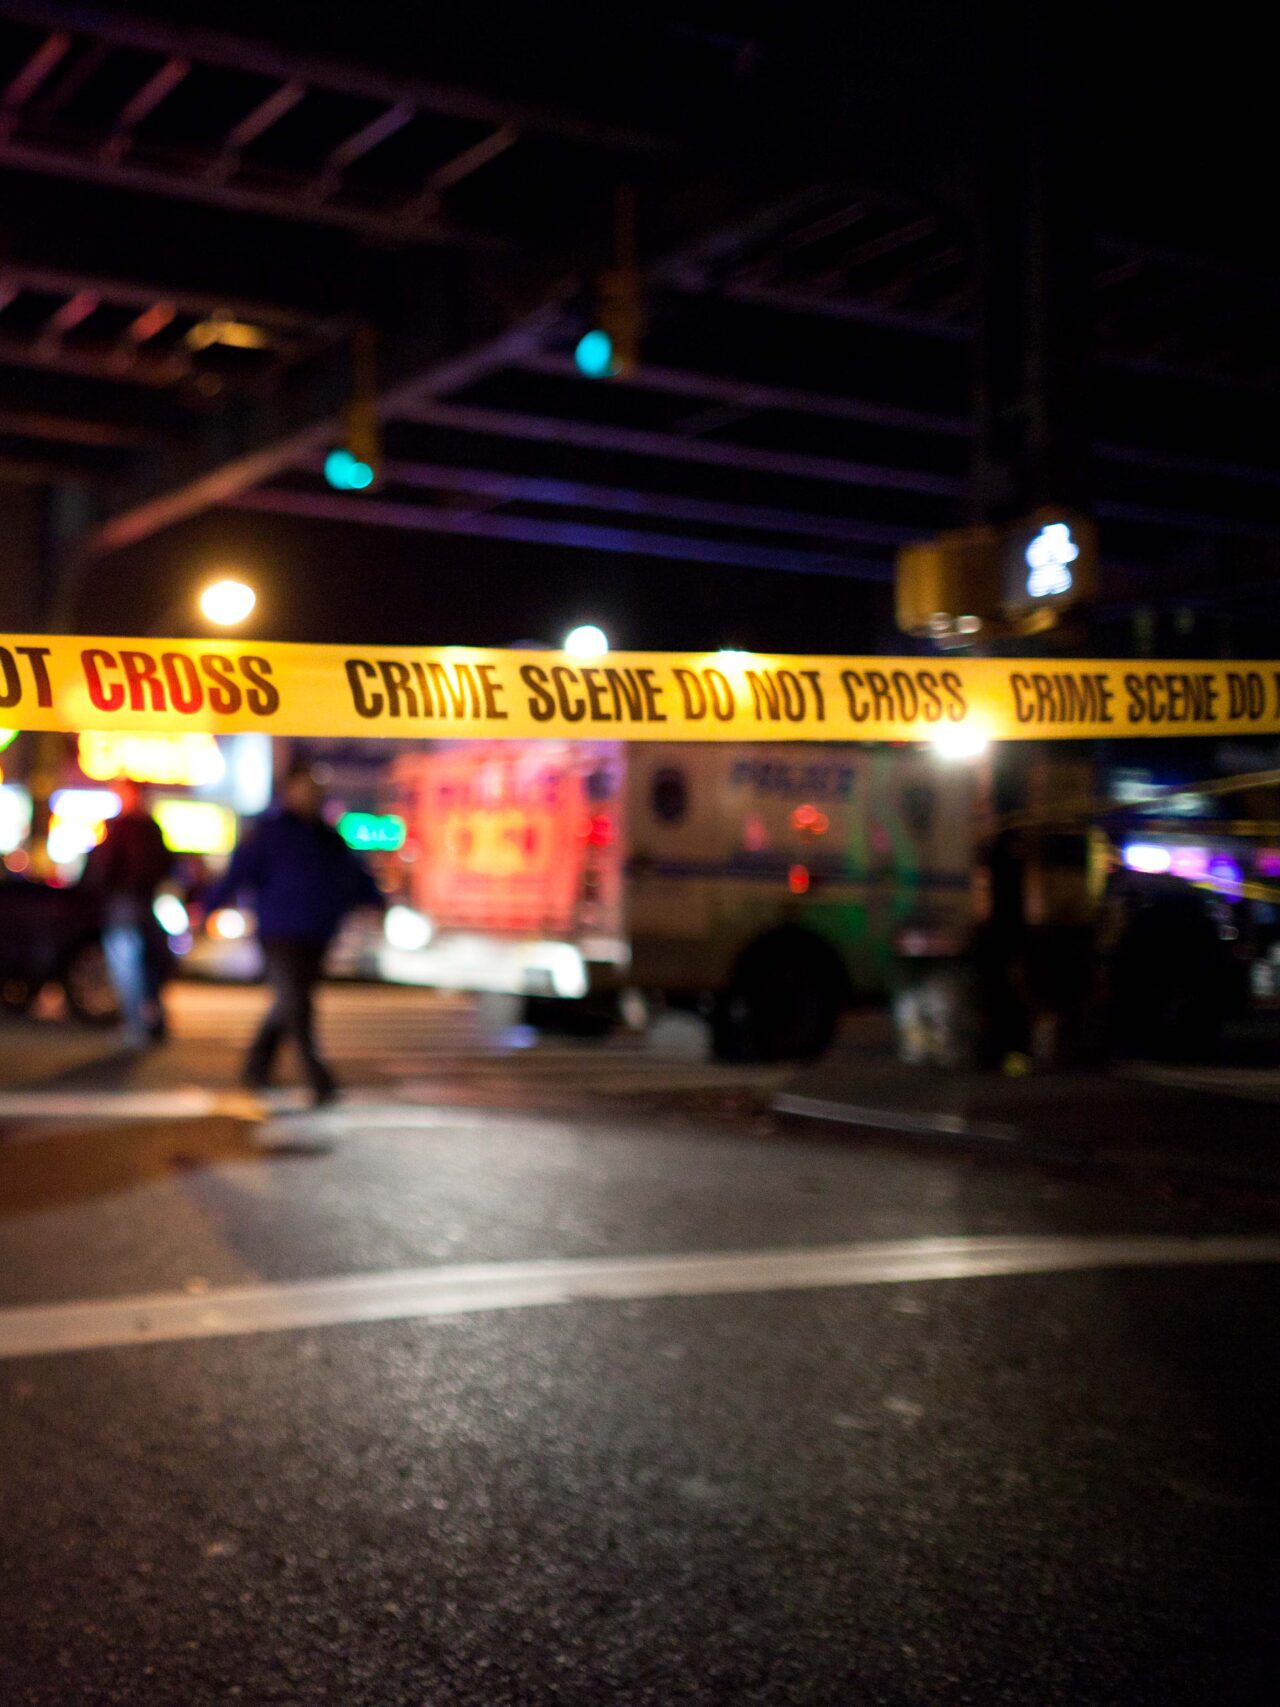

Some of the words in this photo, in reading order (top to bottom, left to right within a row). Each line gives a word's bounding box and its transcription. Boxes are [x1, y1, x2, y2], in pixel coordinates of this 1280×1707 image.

[80, 649, 280, 716] CROSS
[344, 659, 508, 720] CRIME
[519, 664, 667, 722] SCENE
[673, 668, 736, 721] DO
[746, 669, 826, 722] NOT
[840, 670, 968, 722] CROSS
[1009, 673, 1114, 723] CRIME
[1123, 673, 1219, 722] SCENE
[1226, 672, 1265, 720] DO
